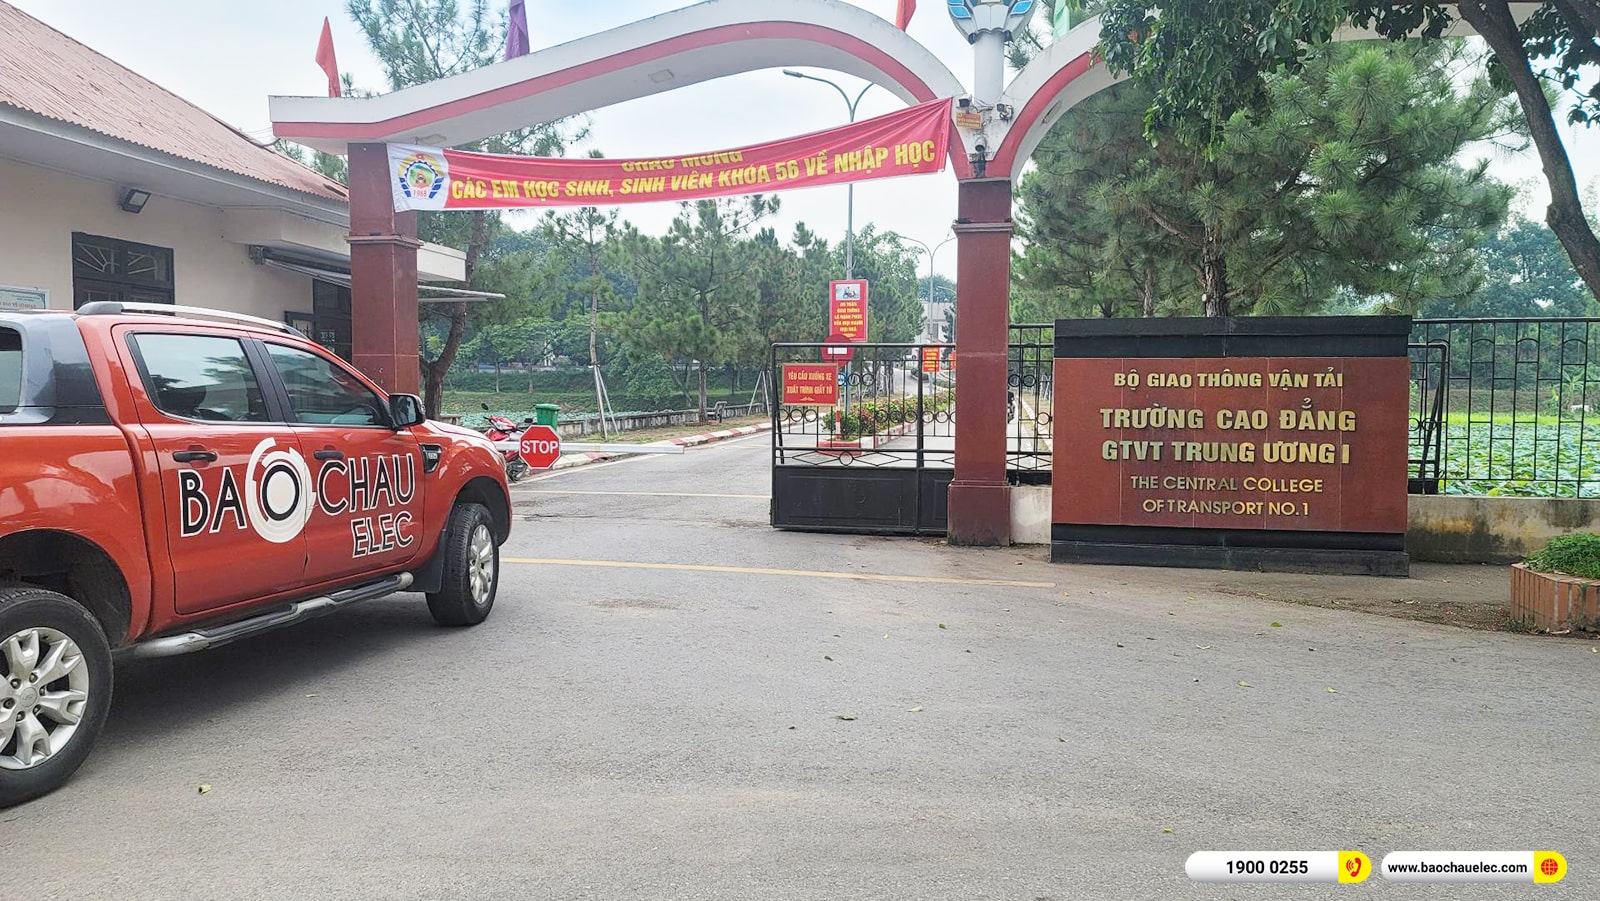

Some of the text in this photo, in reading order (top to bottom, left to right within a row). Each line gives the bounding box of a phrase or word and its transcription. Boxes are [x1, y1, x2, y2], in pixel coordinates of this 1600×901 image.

[451, 140, 935, 202] CÁC EM HỌC SINH, SINH VIÊN KHÓA 56 VỀ NHẬP HỌC
[826, 372, 832, 380] XE
[1113, 366, 1344, 391] BỘ GIAO THÔNG VẬN TẢI
[1100, 397, 1356, 432] TRƯỜNG CAO ĐẲNG
[521, 440, 559, 455] STOP
[1102, 440, 1164, 461] GTVT
[1171, 441, 1255, 464] TRUNG
[1263, 441, 1336, 464] ƯƠNG
[178, 452, 416, 539] BAO CHAU
[1130, 475, 1323, 493] THE CENTRAL COLLEGE
[1142, 499, 1165, 512] OF
[1167, 499, 1264, 515] TRANSPORT
[1268, 501, 1300, 516] NO.
[351, 511, 414, 559] ELEC
